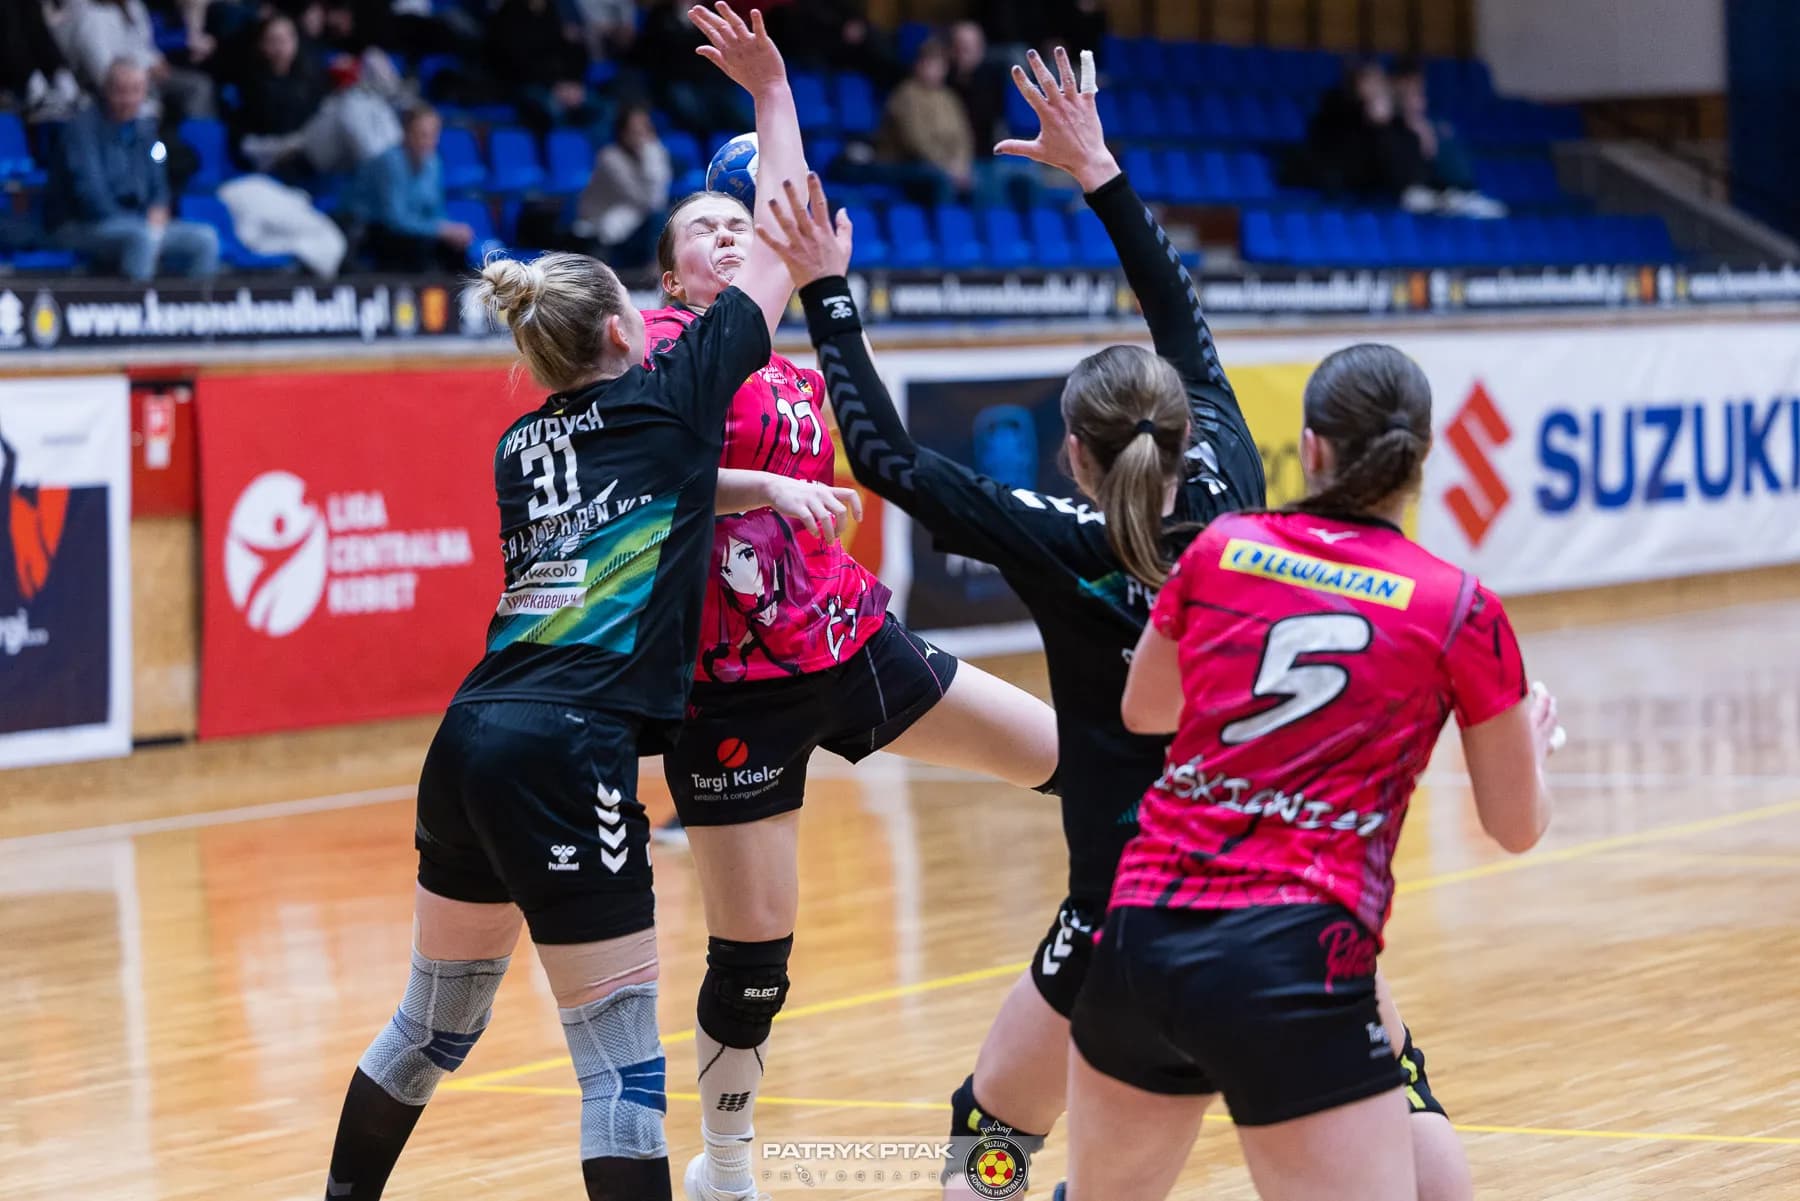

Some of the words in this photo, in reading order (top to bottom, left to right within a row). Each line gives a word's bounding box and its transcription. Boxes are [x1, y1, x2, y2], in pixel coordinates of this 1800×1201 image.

[67, 285, 390, 343] www.koronahandball.pl
[520, 433, 582, 521] 31
[1537, 397, 1800, 514] SUZUKI
[328, 490, 388, 532] LIGA
[330, 527, 474, 574] CENTRALNA
[329, 571, 418, 616] KOBIET
[1221, 613, 1374, 747] 5
[691, 772, 728, 792] Targi
[548, 861, 580, 871] hummel
[743, 986, 779, 998] SELECT
